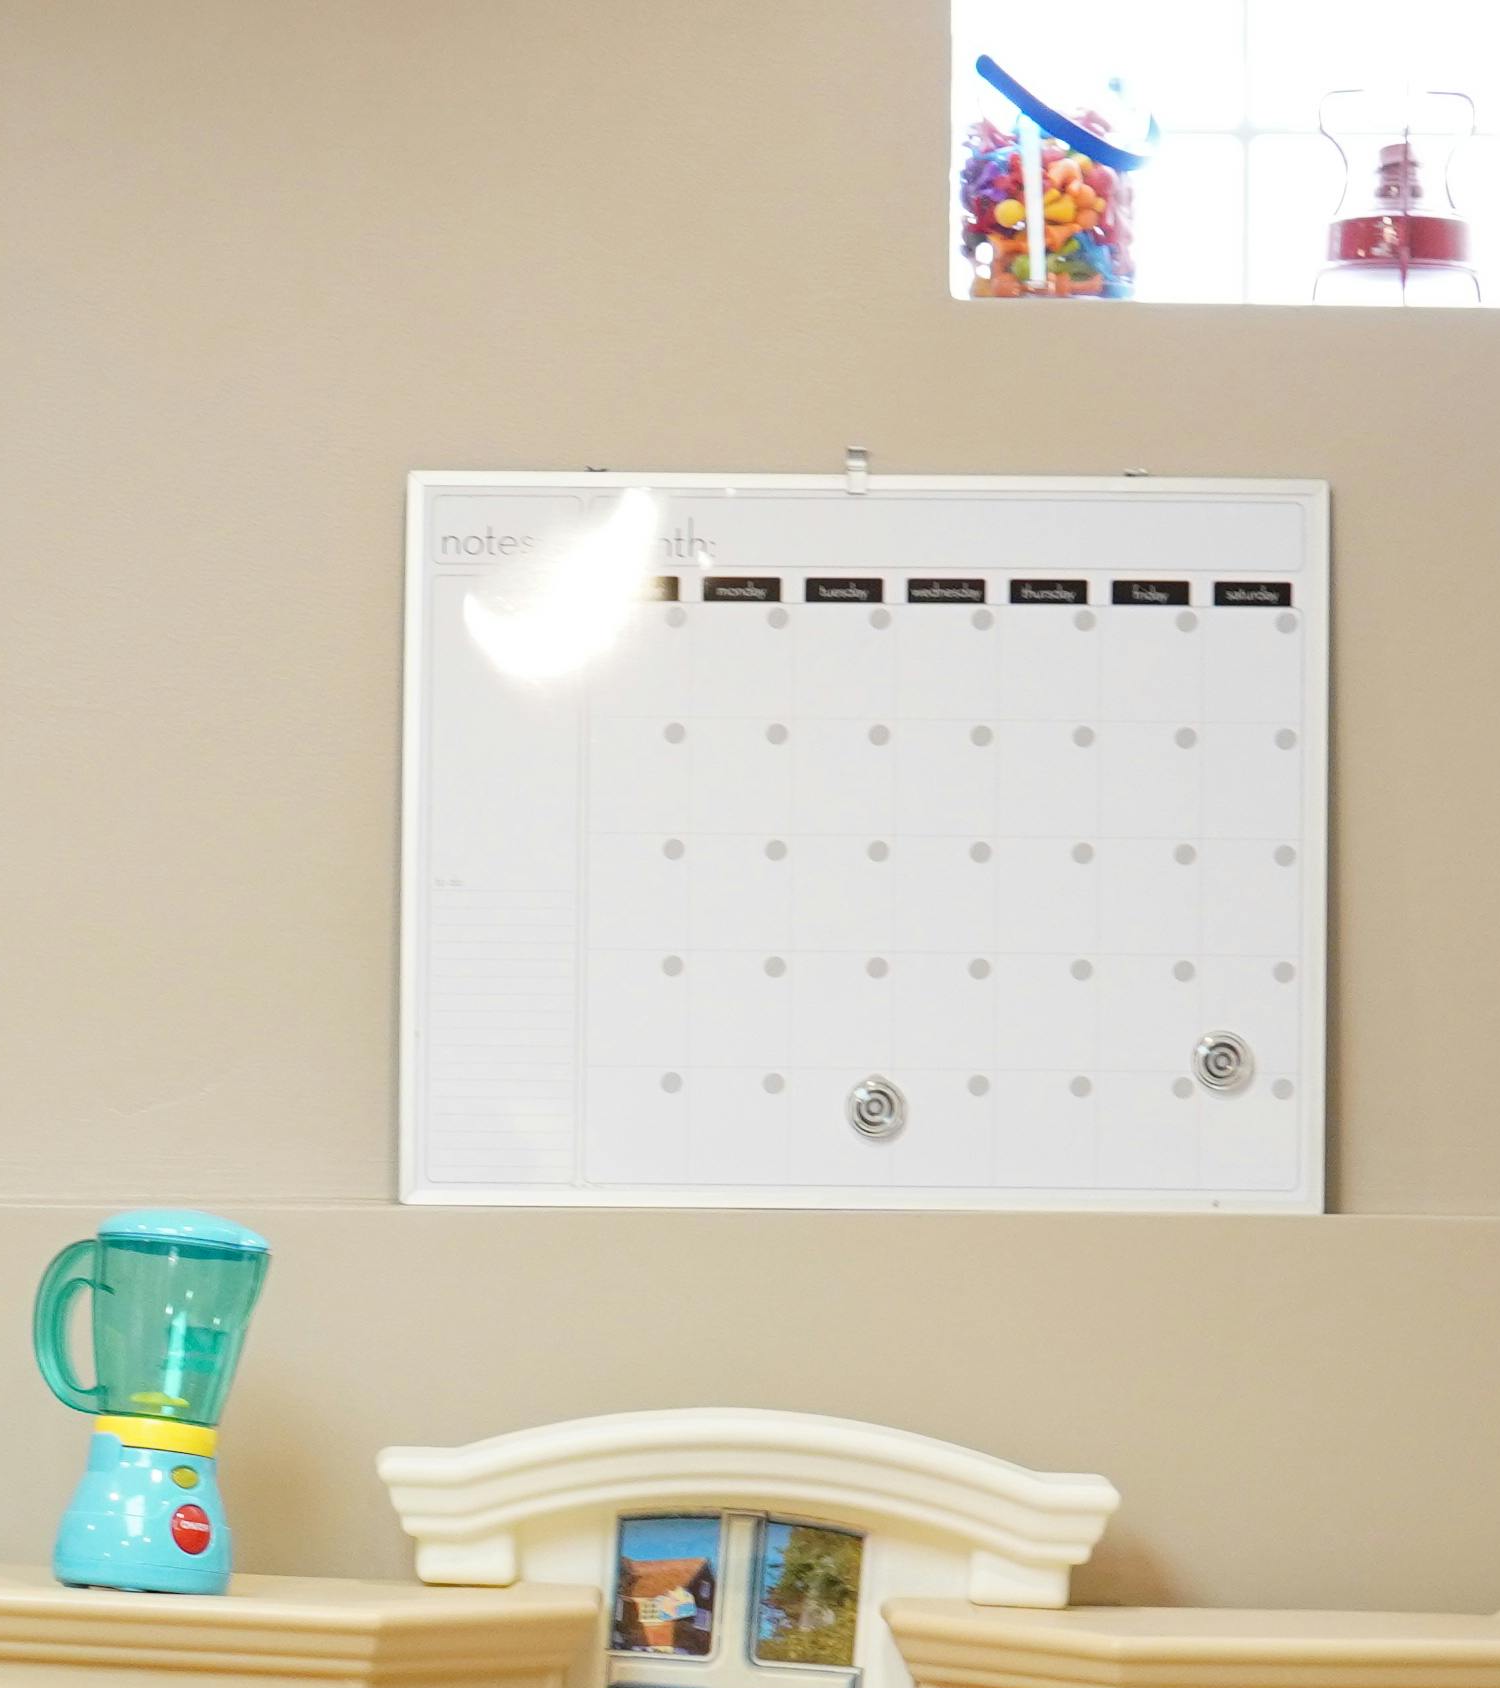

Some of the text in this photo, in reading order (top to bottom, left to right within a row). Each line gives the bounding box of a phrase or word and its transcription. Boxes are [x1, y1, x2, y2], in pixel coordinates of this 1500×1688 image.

[715, 580, 1280, 605] monday tuesday wednesday thursday friday saturday
